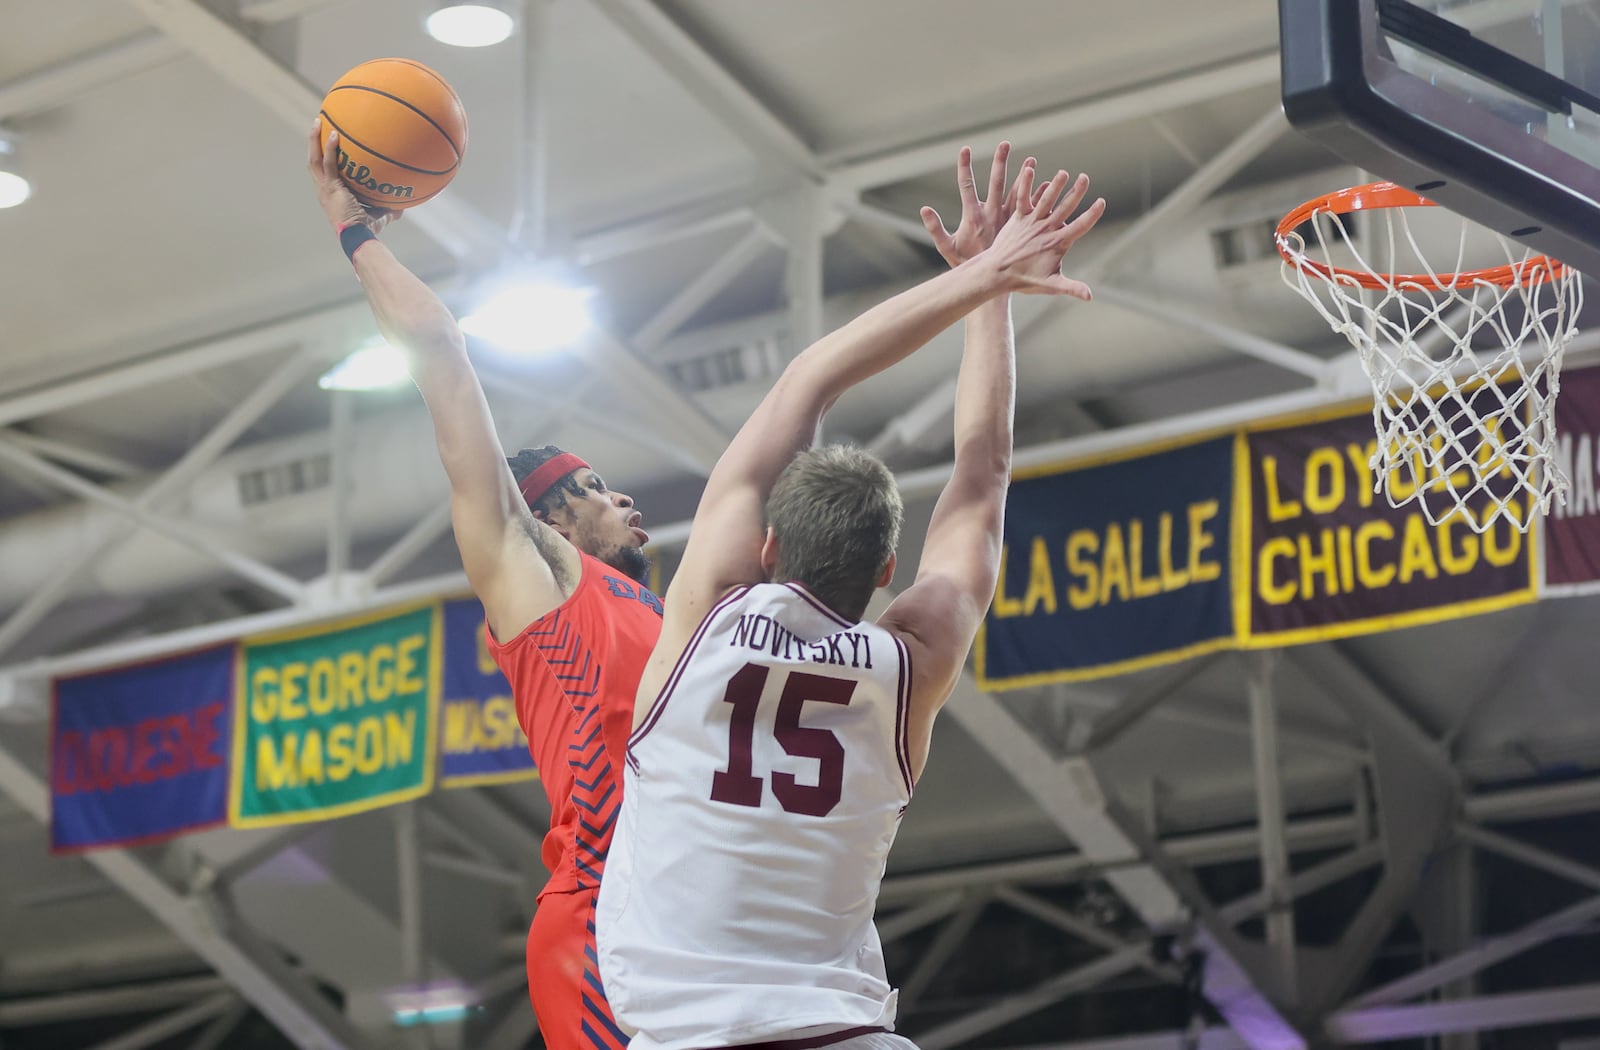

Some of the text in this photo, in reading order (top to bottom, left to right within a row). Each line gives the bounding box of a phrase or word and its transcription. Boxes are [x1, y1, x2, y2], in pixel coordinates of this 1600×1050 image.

[1263, 416, 1512, 522] LOYOLA
[993, 498, 1221, 618] LA SALLE
[1258, 500, 1522, 605] CHICAGO
[252, 634, 425, 724] GEORGE
[730, 614, 873, 669] NOVITSKYI
[256, 709, 416, 791] MASON
[710, 662, 858, 818] 15
